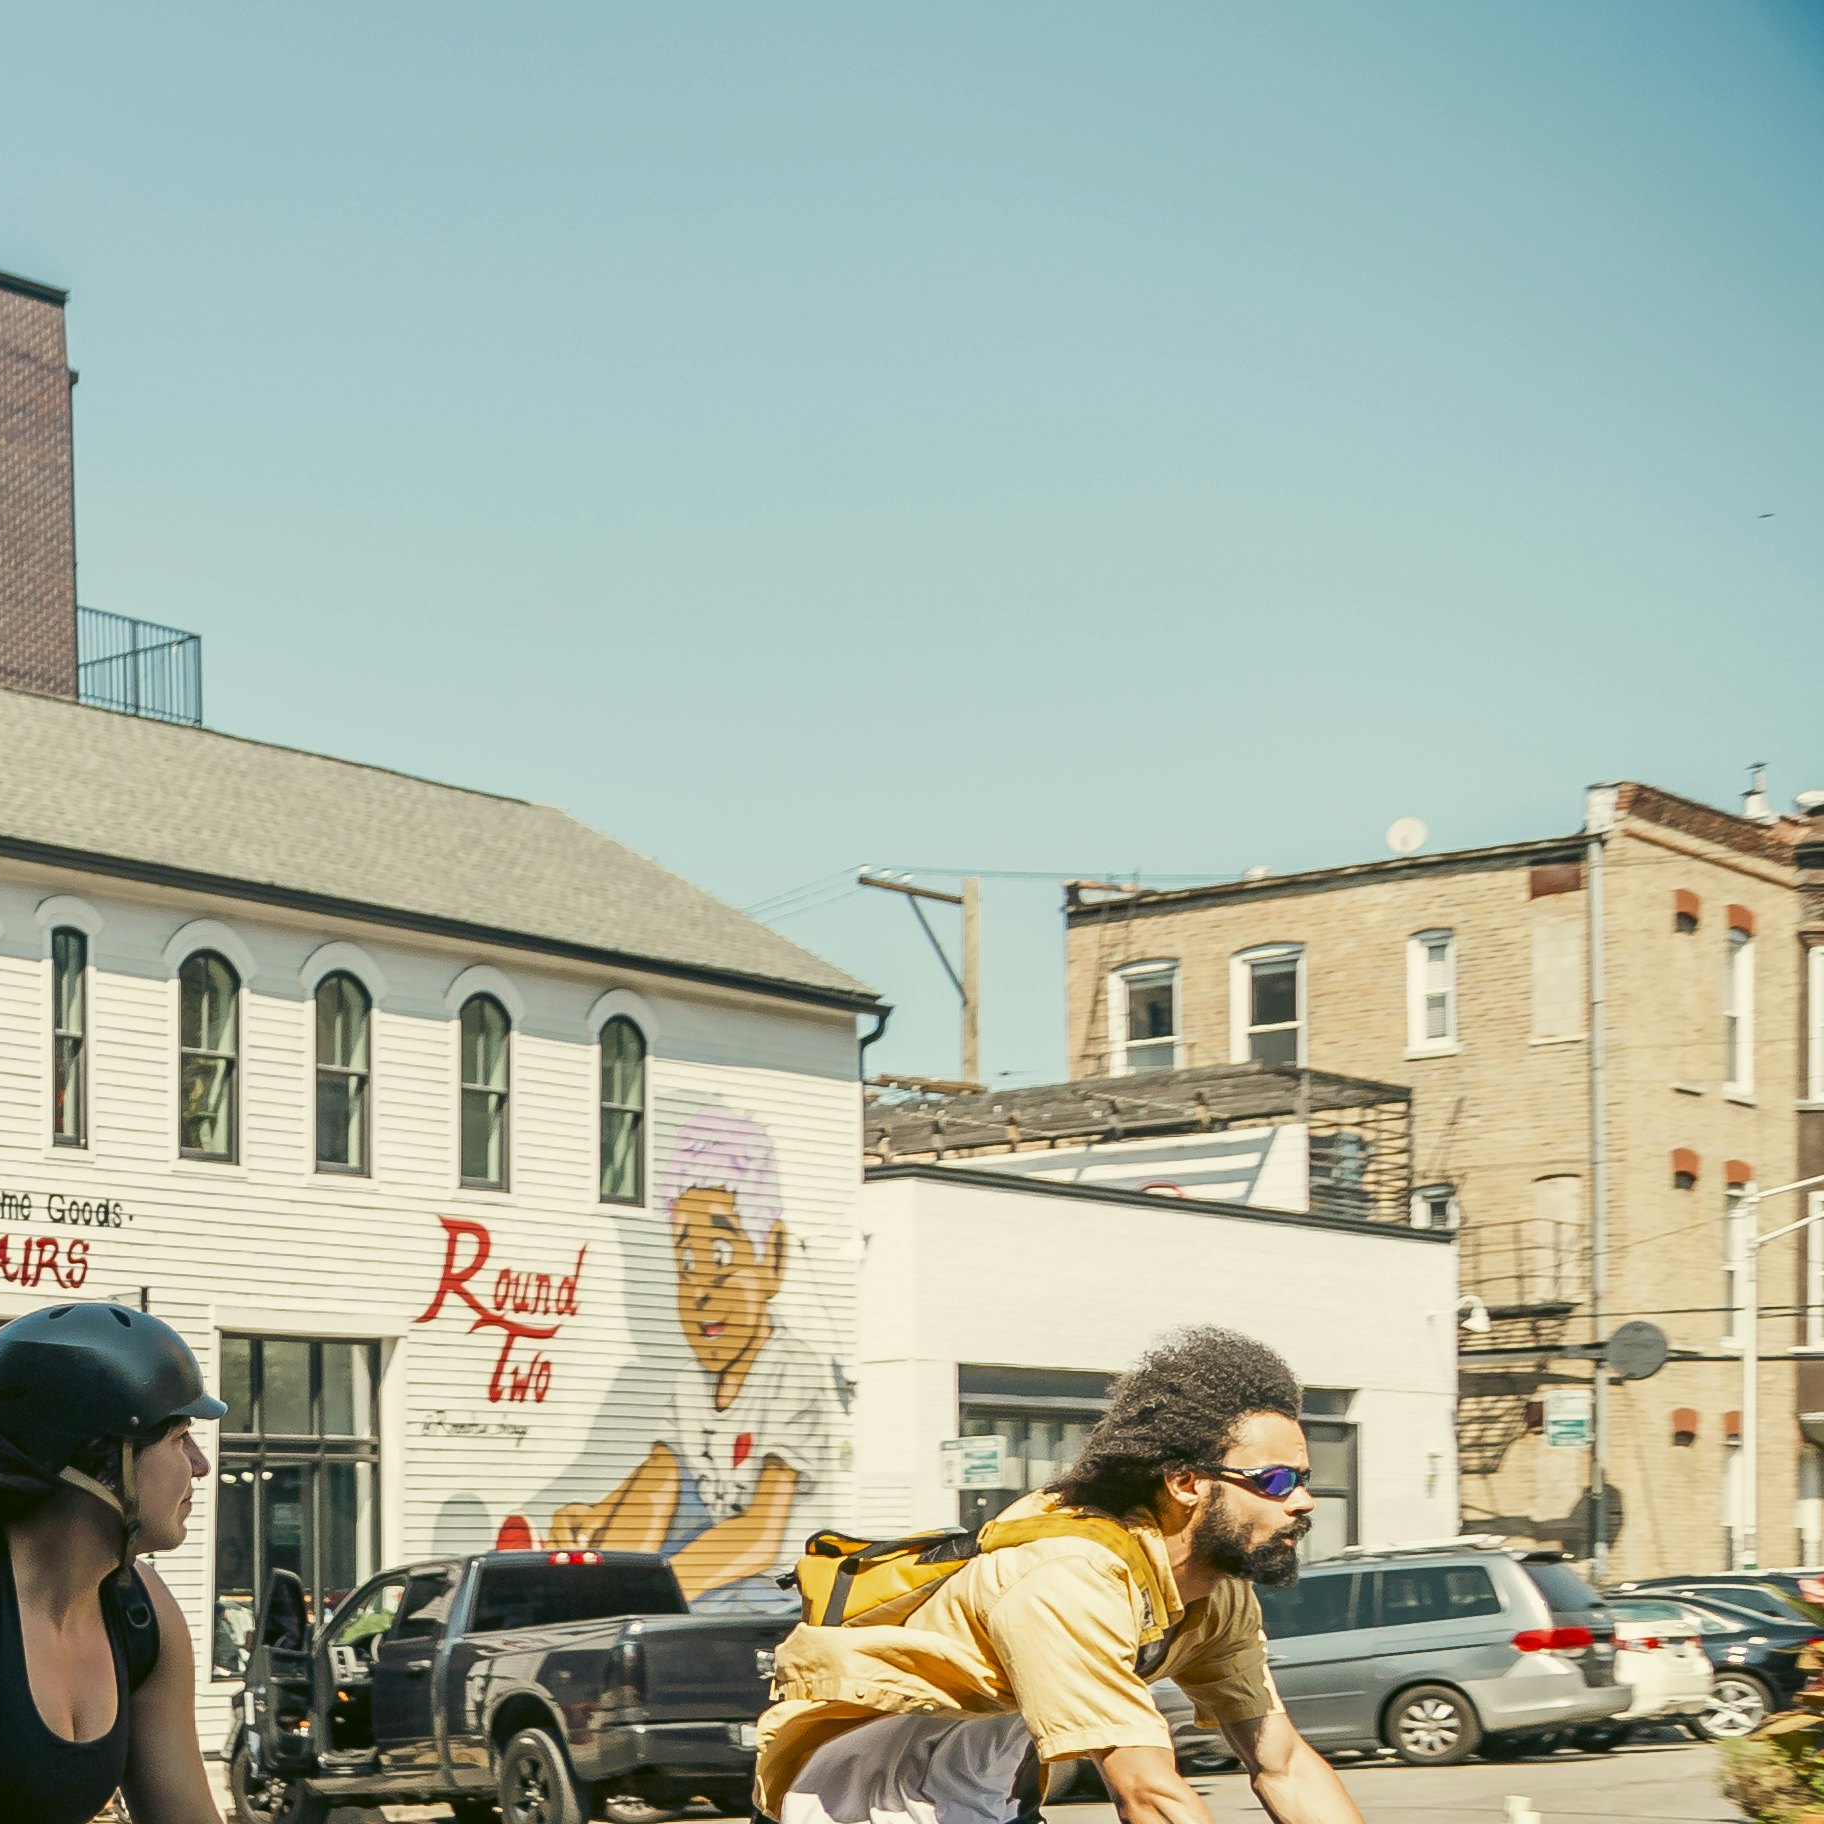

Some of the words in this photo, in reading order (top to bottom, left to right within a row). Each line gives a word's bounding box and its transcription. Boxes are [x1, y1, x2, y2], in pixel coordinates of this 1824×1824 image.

[47, 1192, 123, 1228] Goods
[410, 1212, 589, 1323] Round
[465, 1315, 563, 1403] Two
